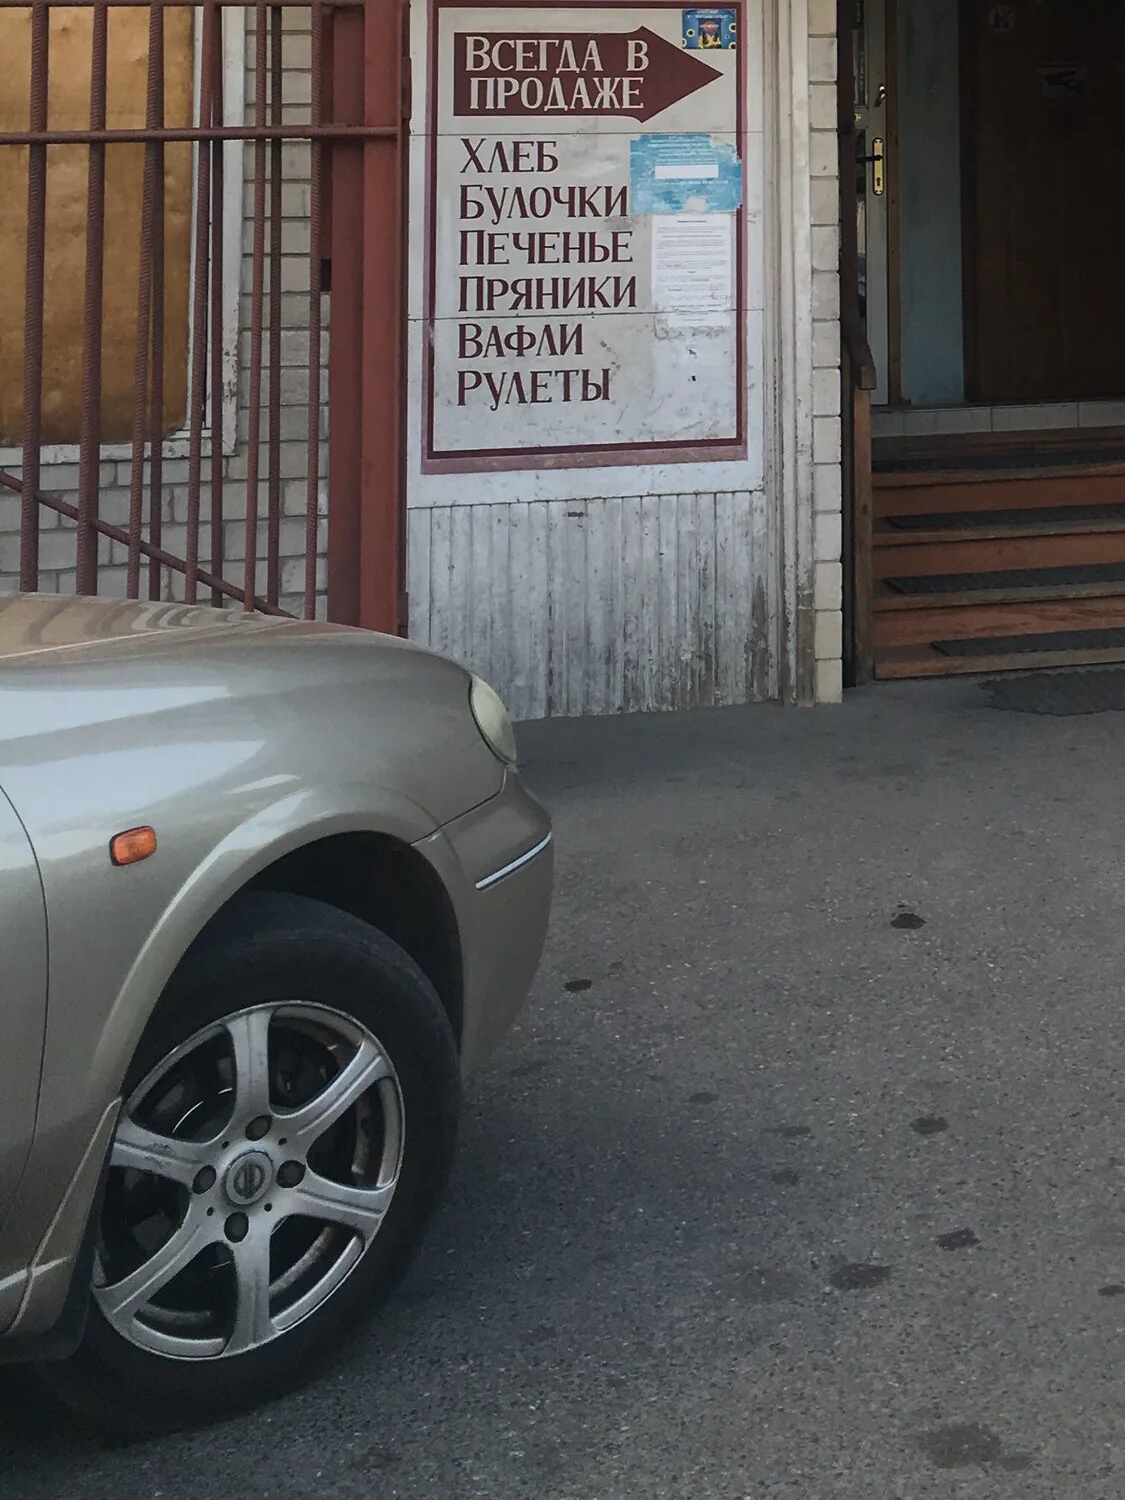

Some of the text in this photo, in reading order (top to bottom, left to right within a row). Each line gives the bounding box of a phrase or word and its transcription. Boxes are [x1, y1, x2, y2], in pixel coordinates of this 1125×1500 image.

[626, 39, 650, 72] В
[469, 75, 645, 112] ПРОДАЖЕ
[460, 138, 559, 174] ХЛЕБ
[459, 184, 628, 225] БУЛОЧКИ
[458, 229, 634, 266] ПЕЧЕНЬЕ
[458, 276, 637, 312] ПРЯНИКИ
[457, 323, 583, 359] ВАФЛИ
[457, 368, 611, 411] РУЛЕТЫ
